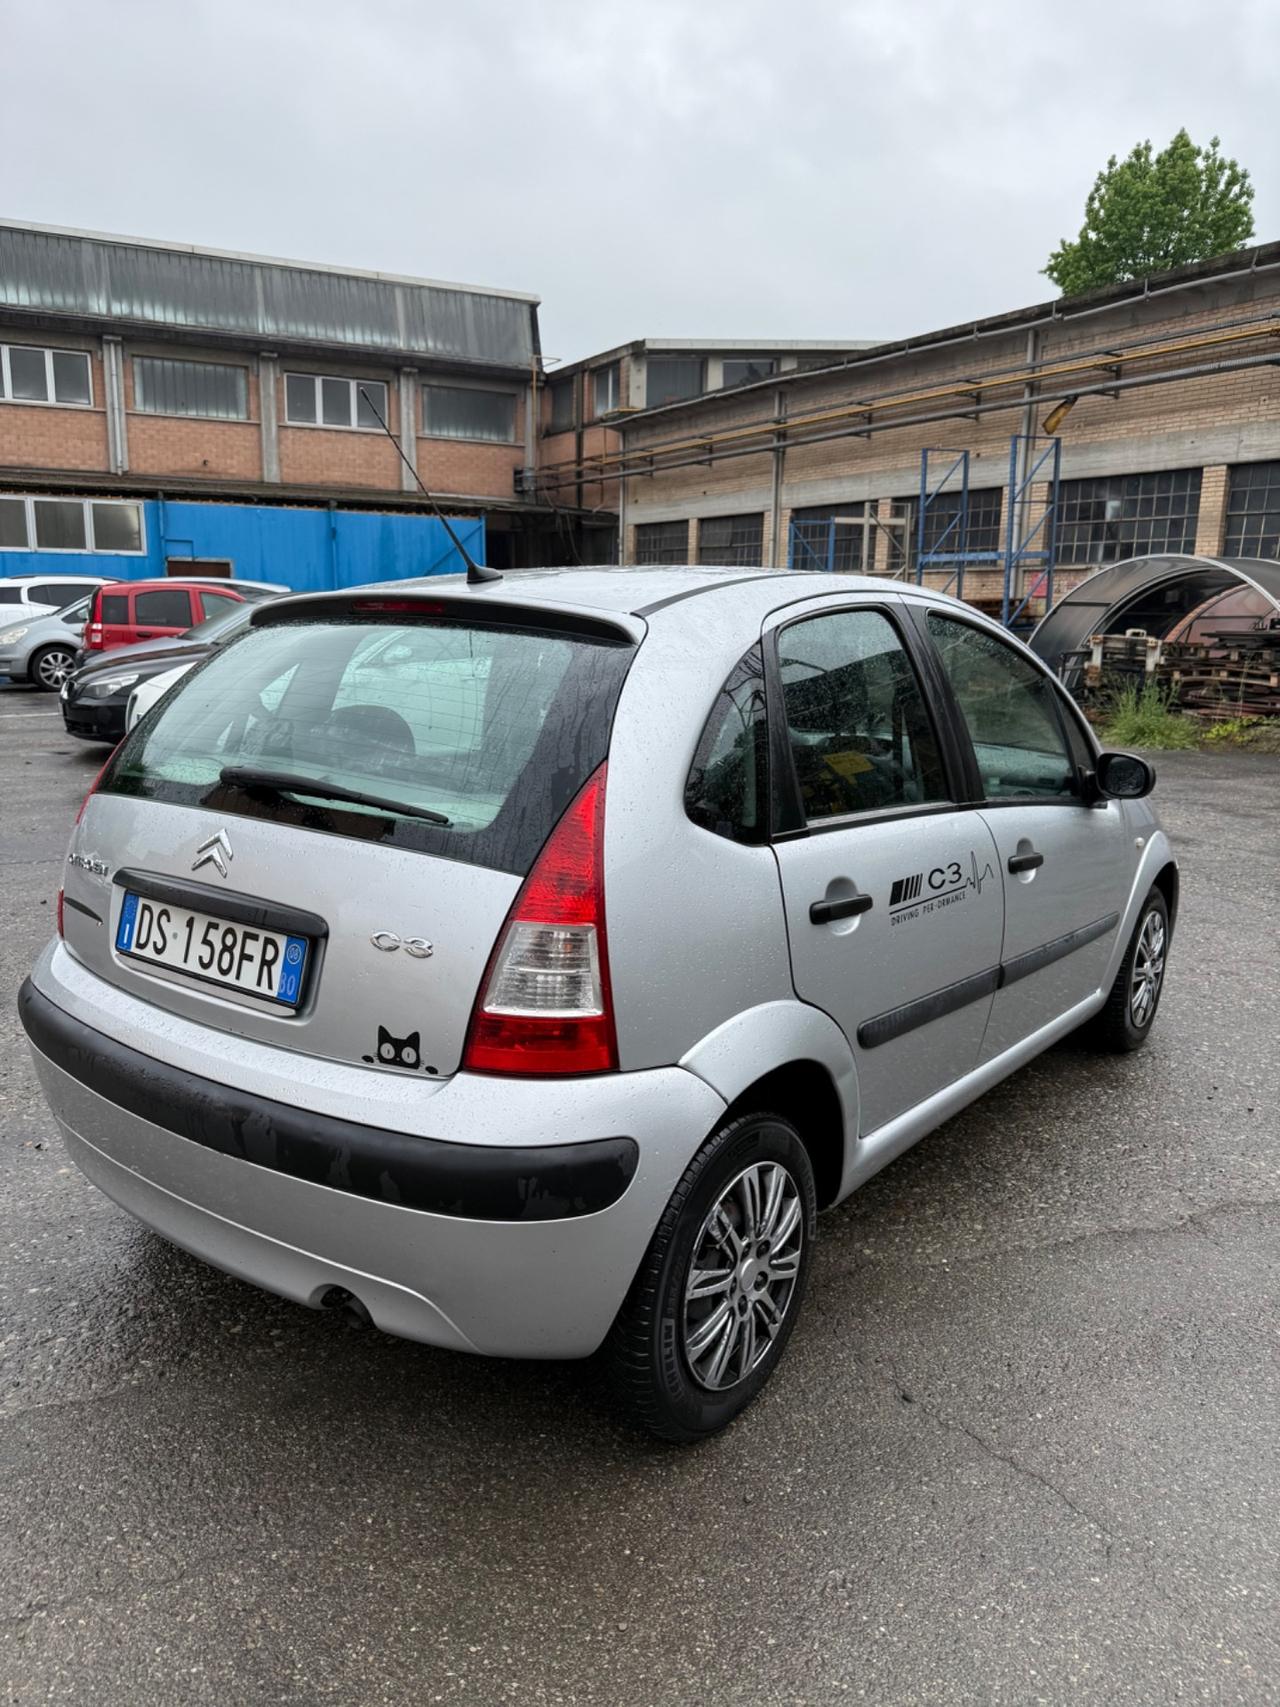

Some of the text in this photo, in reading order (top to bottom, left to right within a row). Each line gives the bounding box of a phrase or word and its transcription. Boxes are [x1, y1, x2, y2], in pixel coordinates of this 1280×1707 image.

[928, 862, 962, 889] C3
[923, 891, 966, 914] PERORMANCE
[890, 908, 919, 926] DRIVING
[135, 903, 279, 991] DS 158FR
[369, 930, 433, 959] C3
